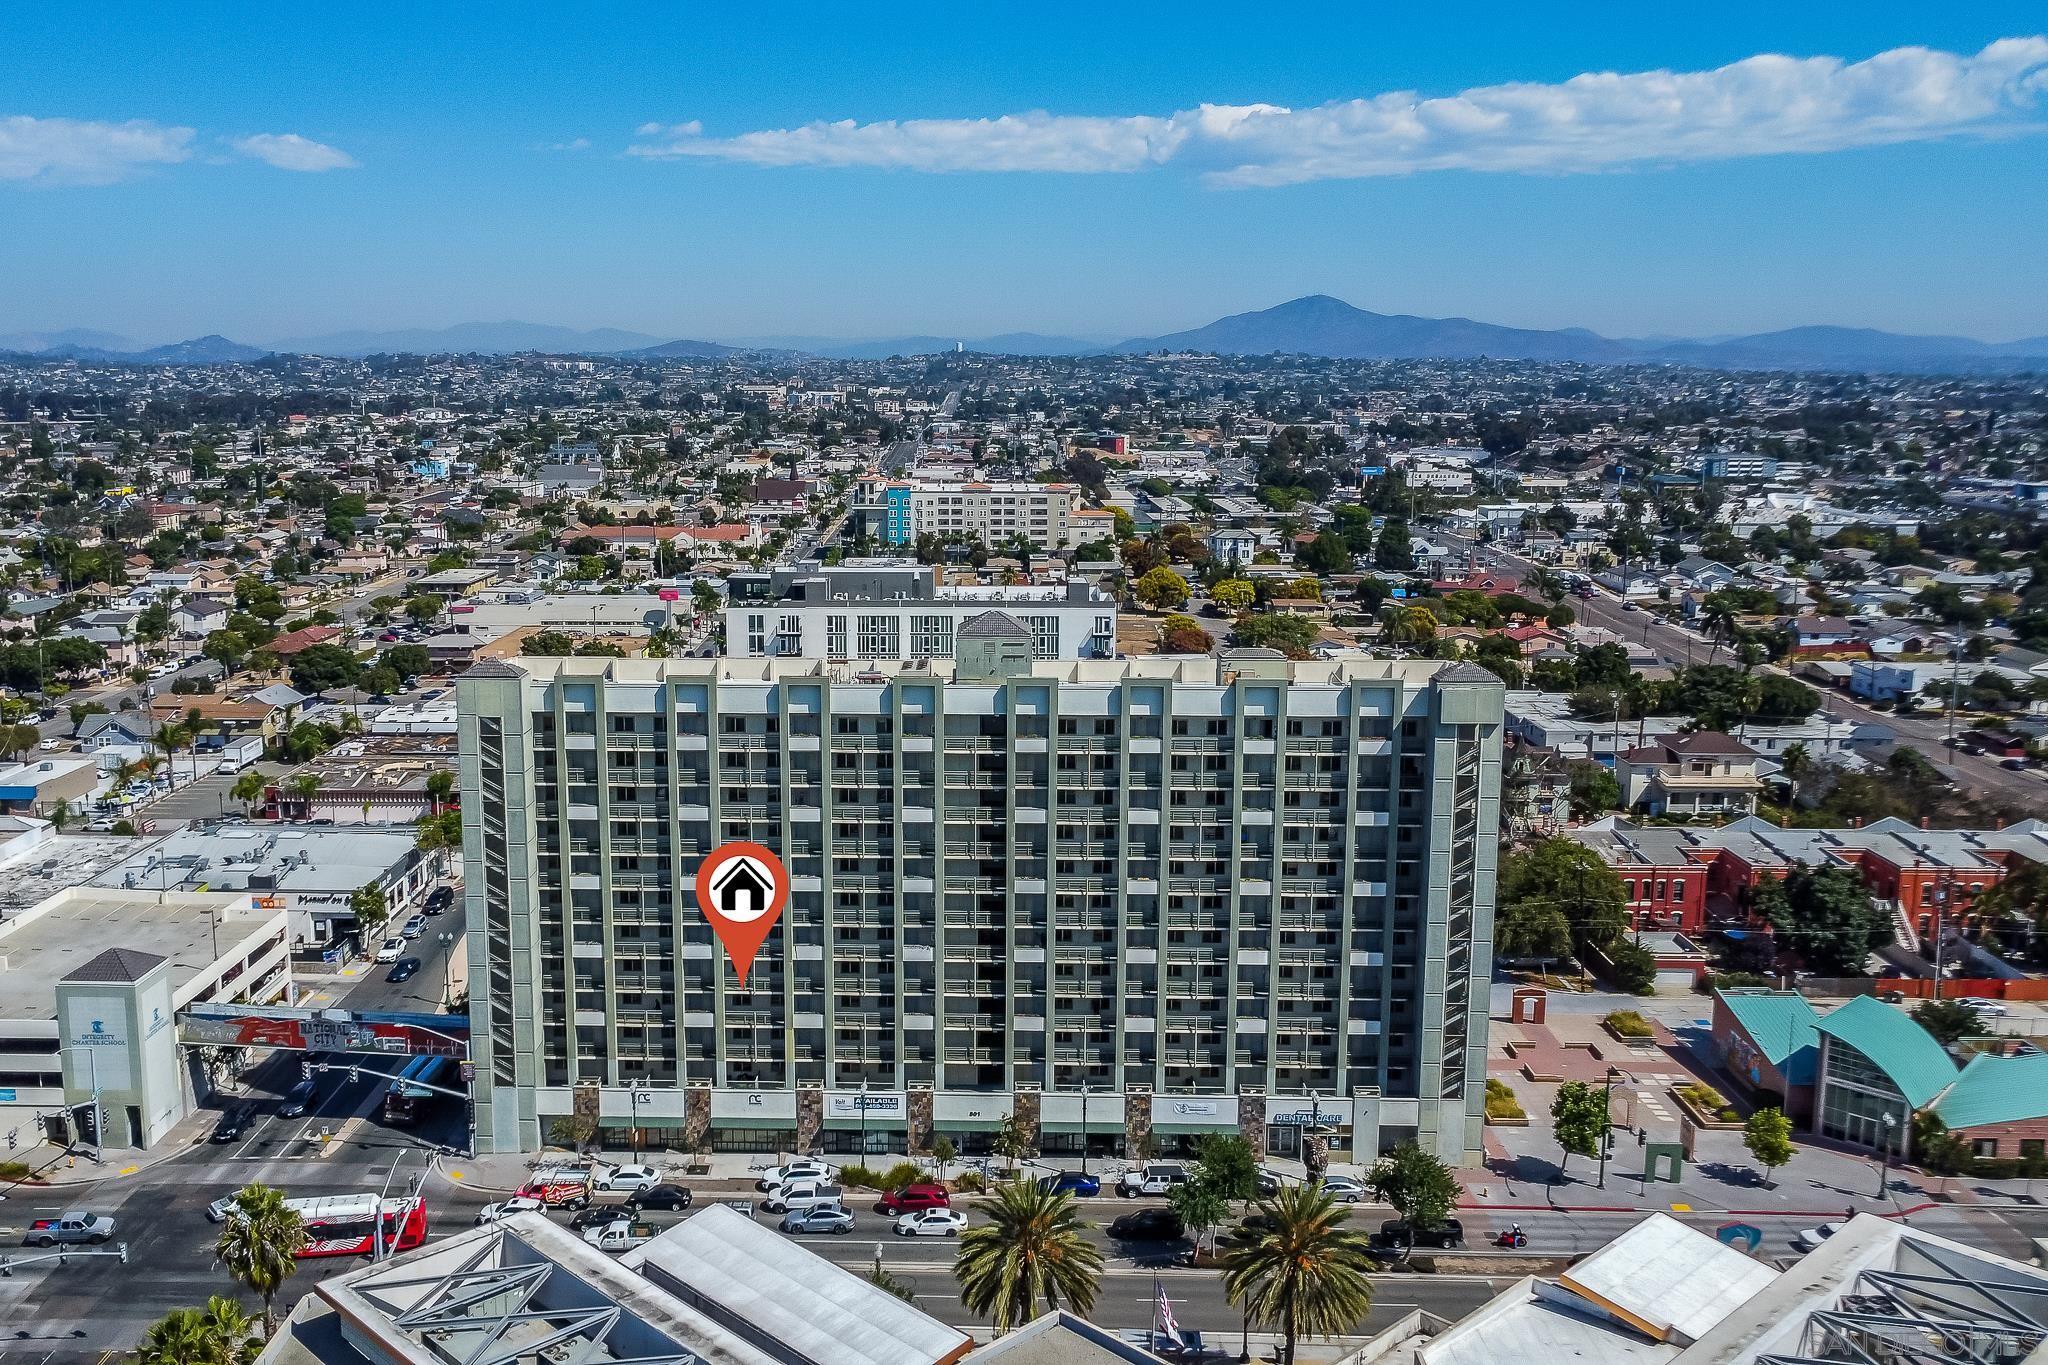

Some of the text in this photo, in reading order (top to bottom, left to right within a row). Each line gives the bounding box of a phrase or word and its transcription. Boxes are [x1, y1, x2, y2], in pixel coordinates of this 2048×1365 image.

[300, 1023, 350, 1036] NATIONAL
[314, 1033, 337, 1045] CITY
[1276, 1114, 1344, 1122] DENTAL CARE
